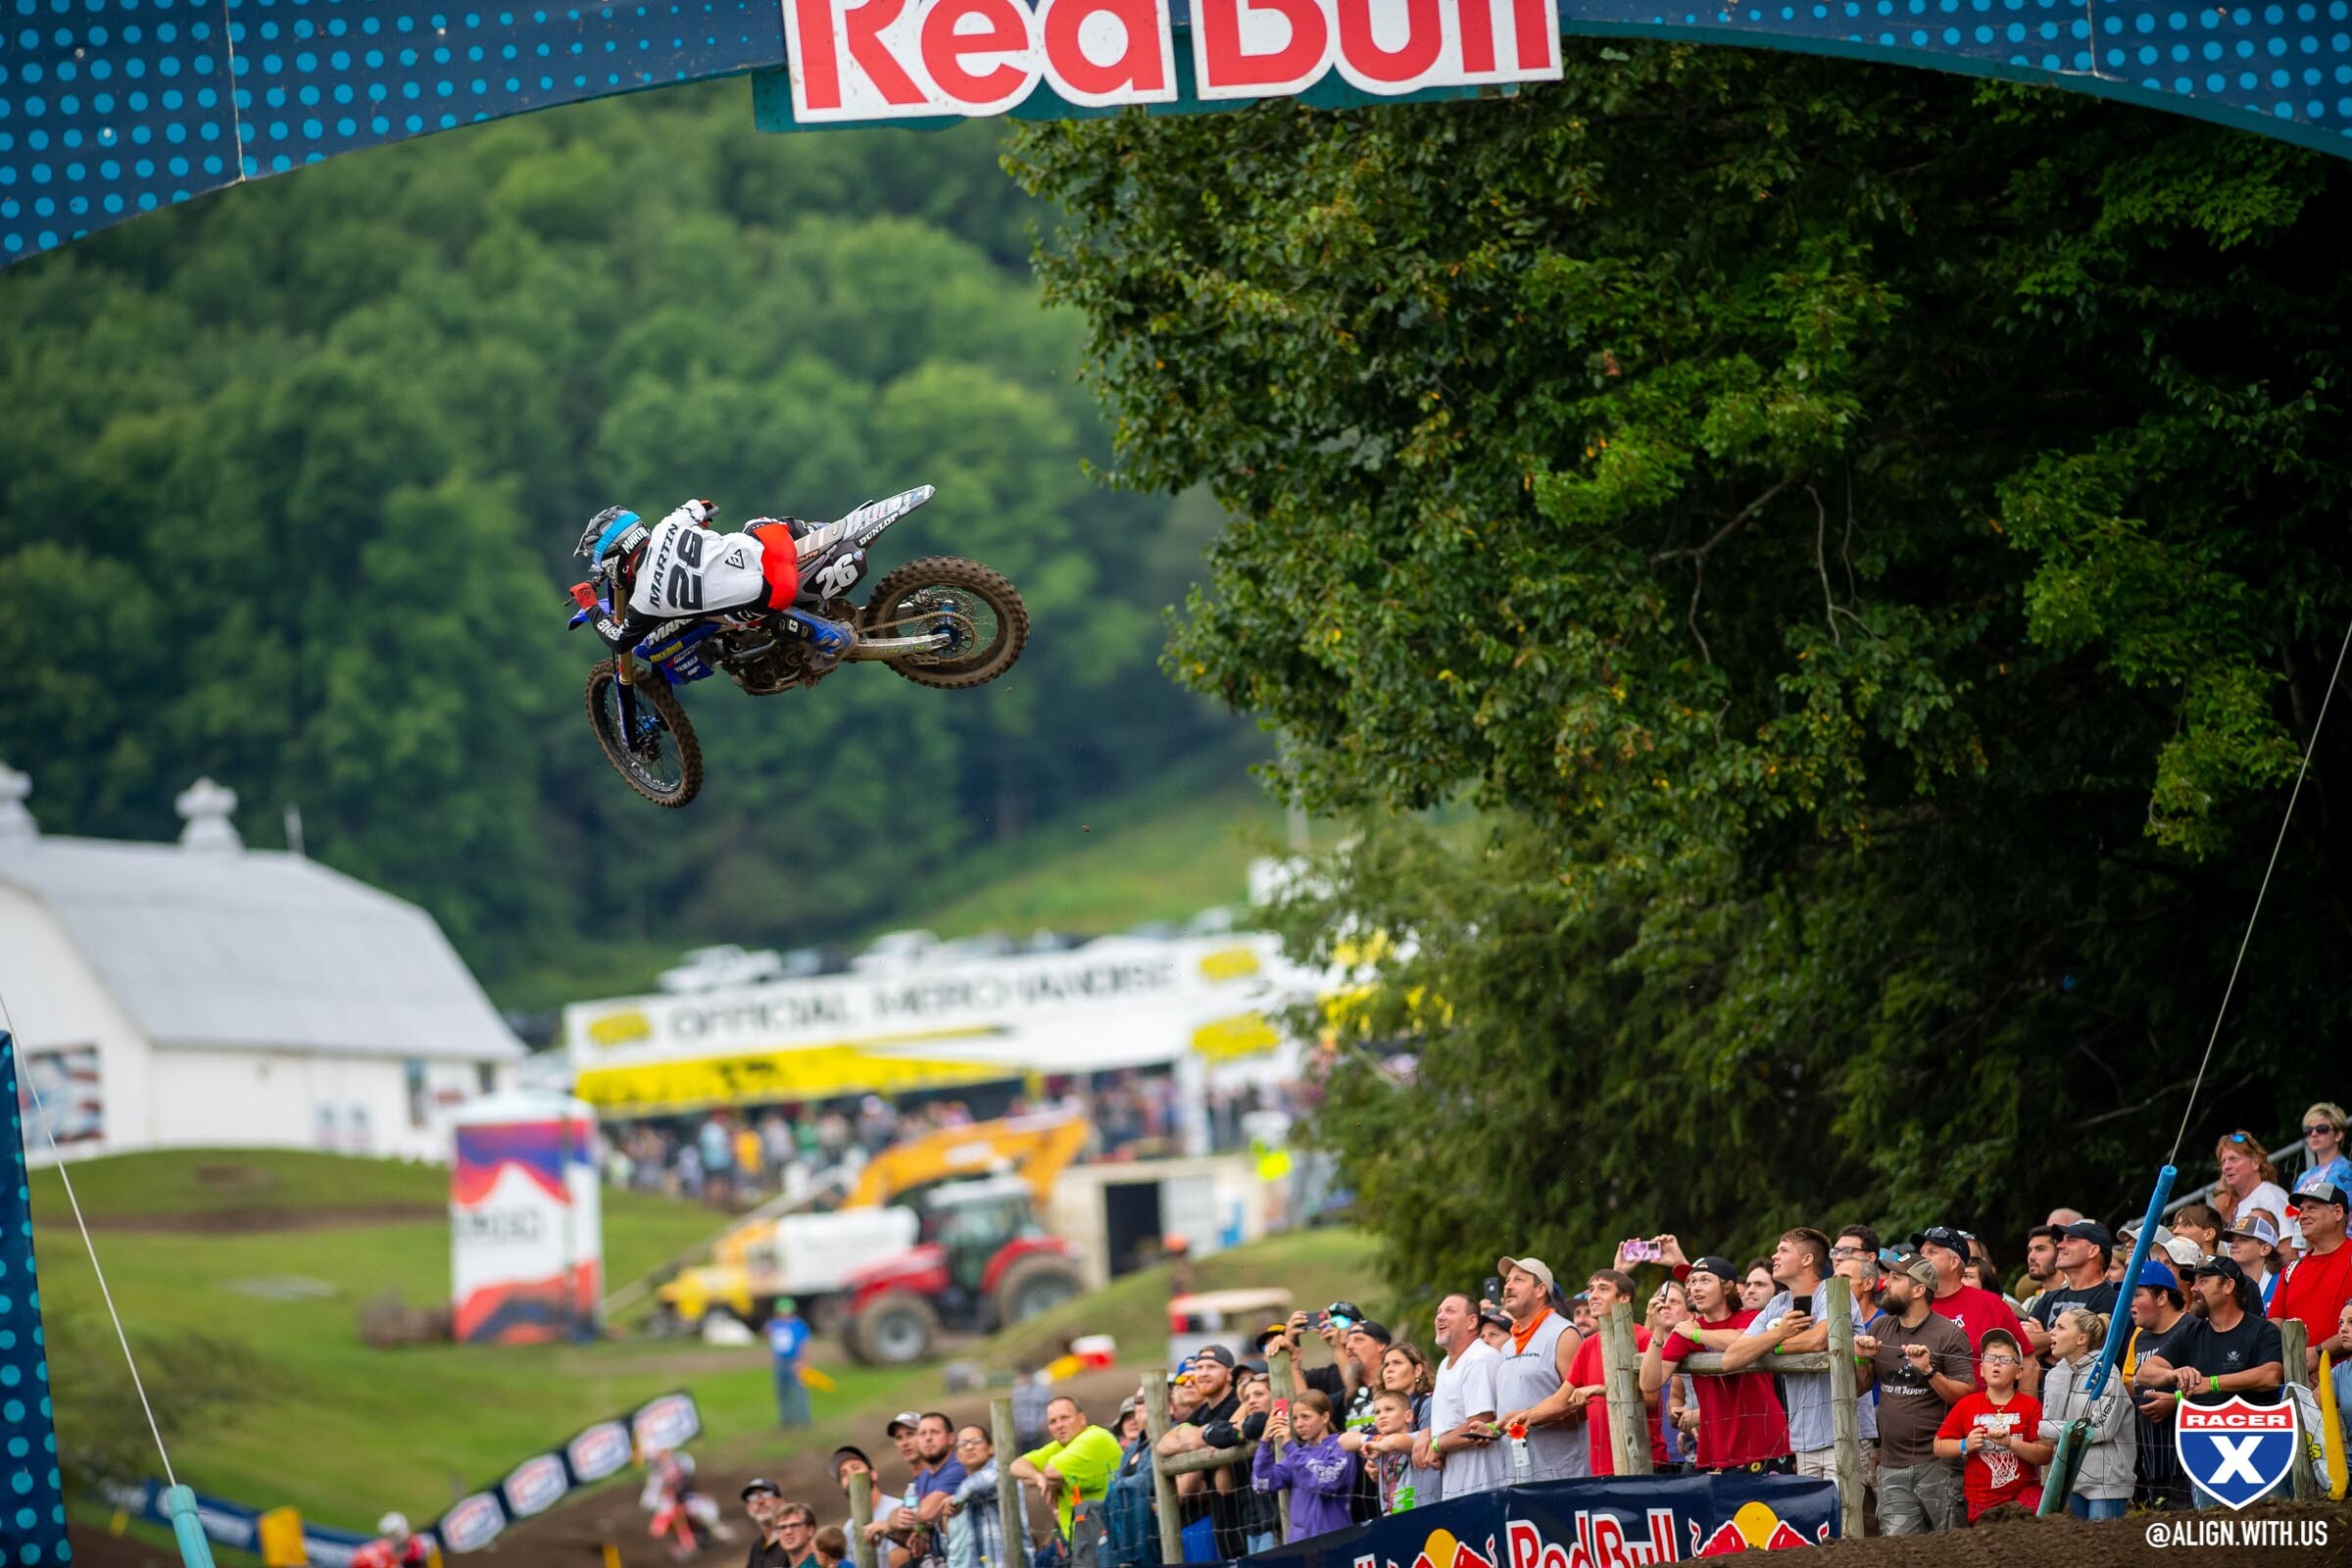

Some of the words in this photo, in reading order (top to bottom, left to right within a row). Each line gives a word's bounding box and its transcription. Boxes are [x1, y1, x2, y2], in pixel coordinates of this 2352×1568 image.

[858, 513, 899, 547] DUNLOP
[650, 523, 678, 609] MARTIN
[815, 553, 858, 600] 26
